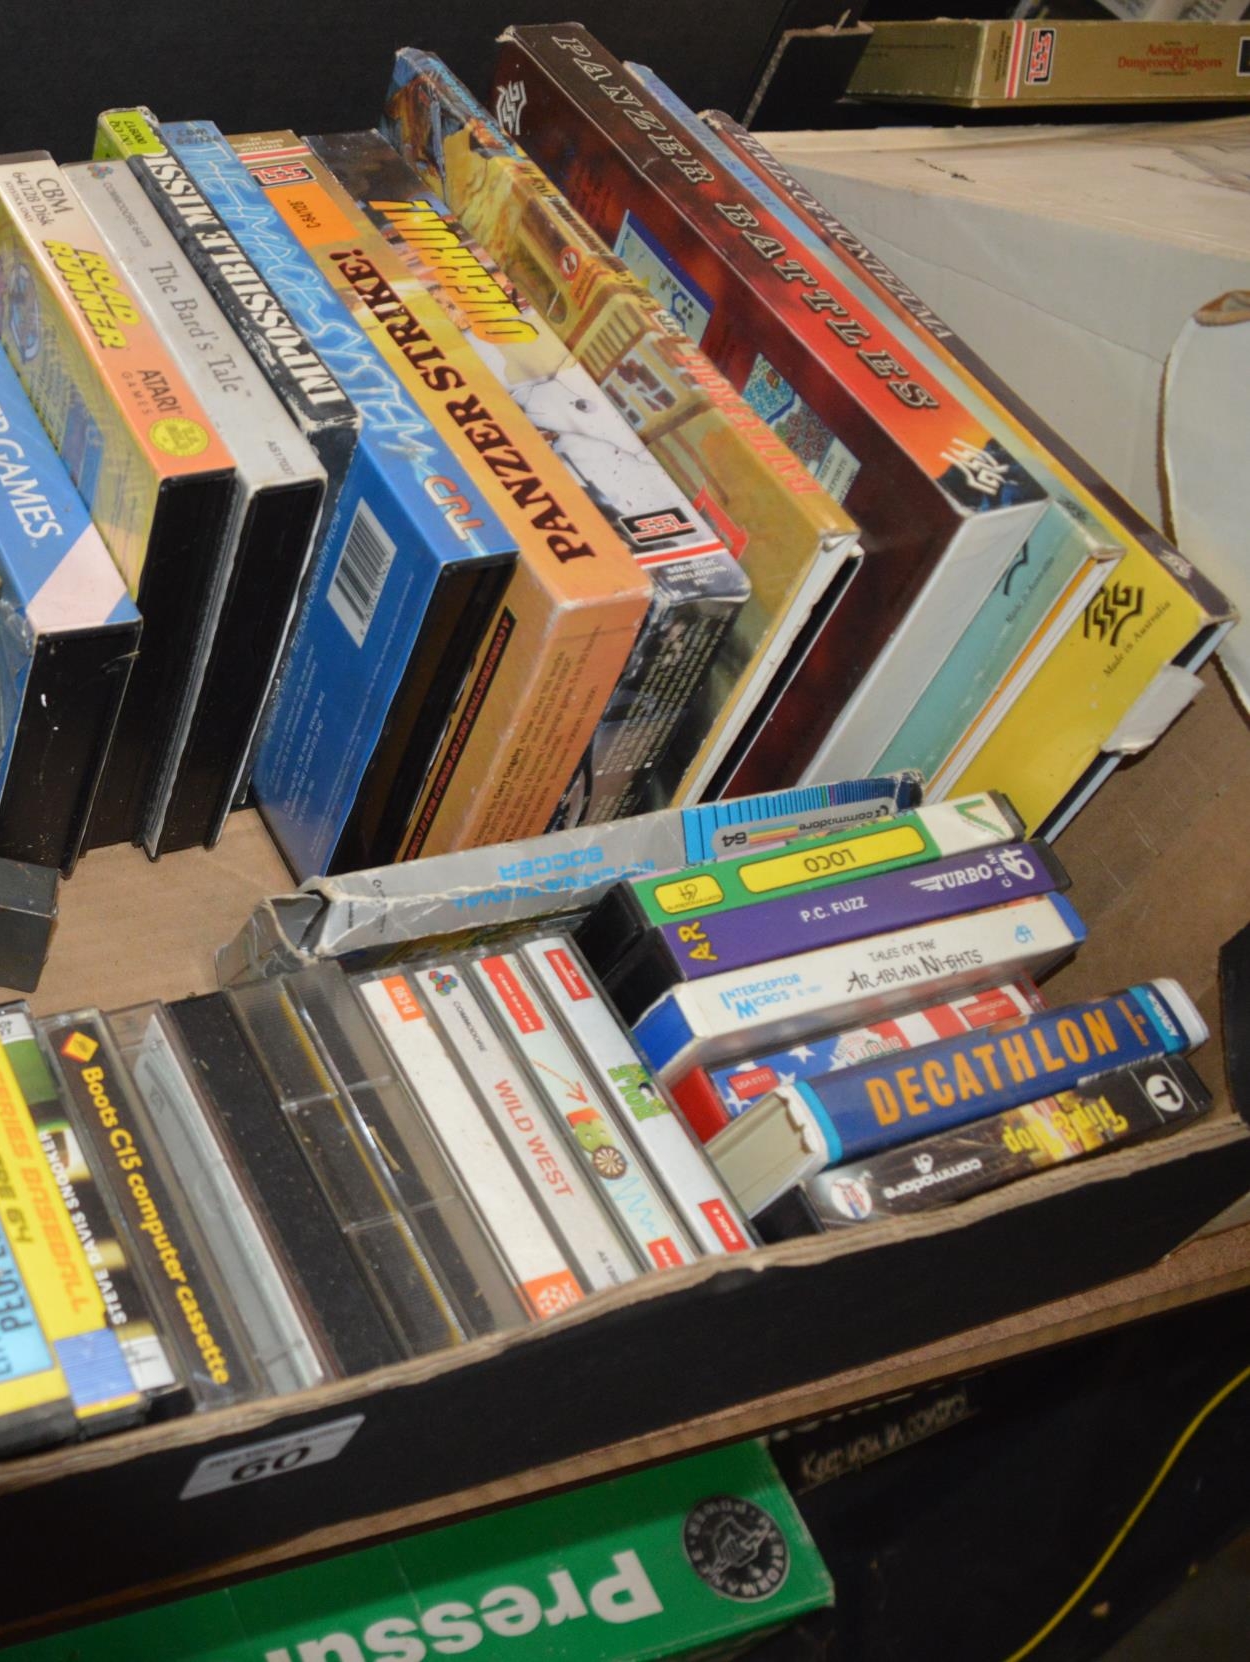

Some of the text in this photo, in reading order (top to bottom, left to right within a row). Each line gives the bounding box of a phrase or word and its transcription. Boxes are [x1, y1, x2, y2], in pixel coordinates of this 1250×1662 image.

[1147, 43, 1198, 58] Advanced
[12, 171, 57, 227] 64/128 Disk
[37, 178, 74, 215] CBM
[552, 35, 940, 410] PANZER BATTLES
[733, 133, 801, 192] HALLS
[815, 210, 954, 341] MONTEZUMA
[42, 239, 129, 350] RUNNER
[80, 247, 141, 327] ROAD
[369, 200, 540, 344] OVERRUN!
[148, 260, 240, 394] The Bard's Tale
[195, 219, 346, 416] IMPOSSIBLE
[328, 248, 467, 393] STRIKE!
[120, 371, 153, 416] GAMES
[137, 368, 183, 415] ATARI
[446, 393, 596, 565] PANZER
[424, 474, 486, 542] CRL
[631, 512, 697, 541] SSI
[1102, 651, 1126, 679] Made
[1131, 599, 1173, 642] Australia
[460, 629, 511, 719] CONSTRUCTION
[721, 808, 875, 848] commodore 64
[497, 845, 605, 882] SOCCER
[803, 846, 857, 874] LOCO
[911, 862, 994, 893] TURBO
[1001, 845, 1037, 881] 64
[680, 882, 700, 901] 64
[799, 895, 869, 924] P.C. FUZZ
[868, 938, 938, 962] TALES OF THE
[1014, 924, 1036, 945] 64
[718, 972, 803, 1011] INTERCEPTOR
[845, 960, 921, 994] ARABIAN
[452, 999, 488, 1053] COMMODORE
[864, 1006, 1118, 1128] DECATHLON
[493, 1077, 576, 1198] WILD WEST
[883, 1156, 983, 1201] commodore
[914, 1153, 933, 1174] 64
[5, 1205, 34, 1246] 64
[20, 1166, 93, 1315] BASEBALL
[39, 1130, 128, 1327] STEVE DAVIS SNOOKER
[80, 1064, 230, 1386] Boots C15 computer cassette
[231, 1447, 311, 1482] 60
